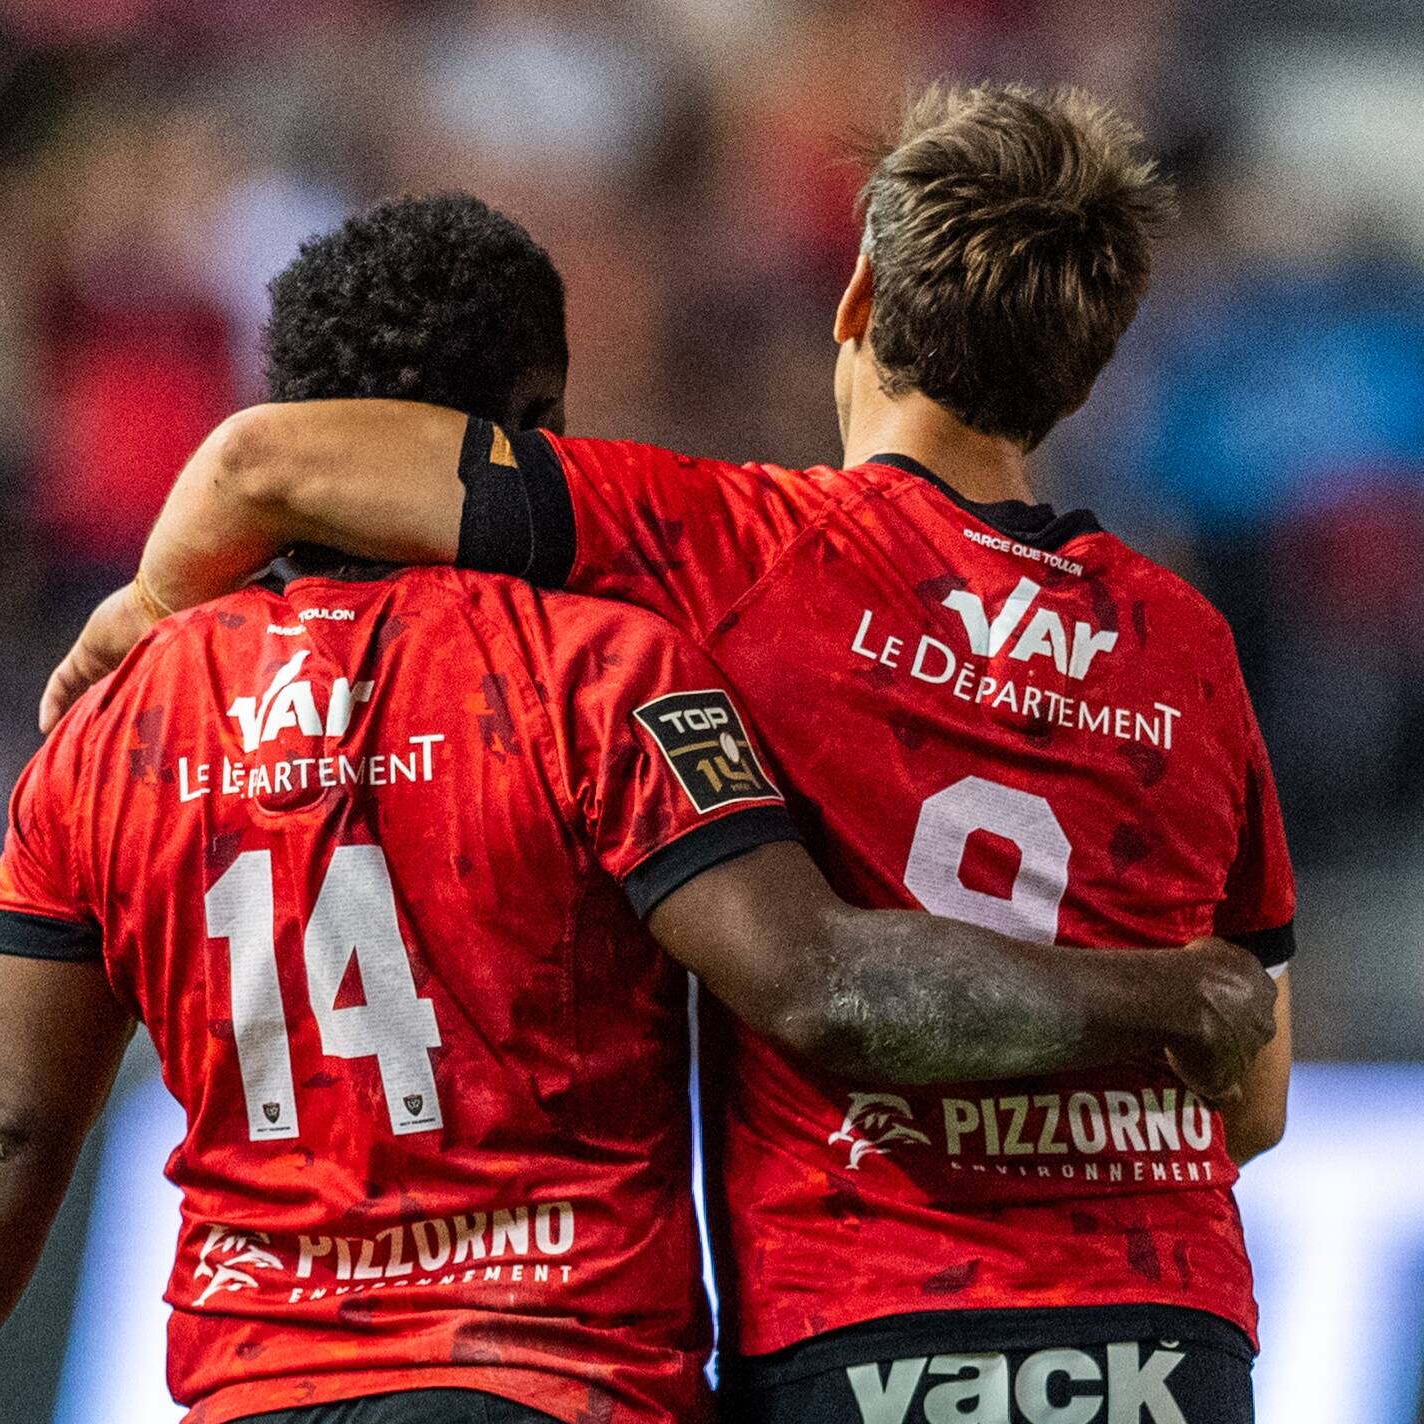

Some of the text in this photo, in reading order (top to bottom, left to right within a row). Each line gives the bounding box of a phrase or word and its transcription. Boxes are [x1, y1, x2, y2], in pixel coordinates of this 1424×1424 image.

[963, 529, 1083, 576] PARCE QUE TOULON
[850, 610, 903, 668] LE
[659, 707, 728, 734] TOP
[695, 755, 761, 792] 14
[204, 844, 444, 1141] 14
[942, 1088, 1212, 1156] PIZZORNO
[296, 1201, 575, 1281] PIZZORNO
